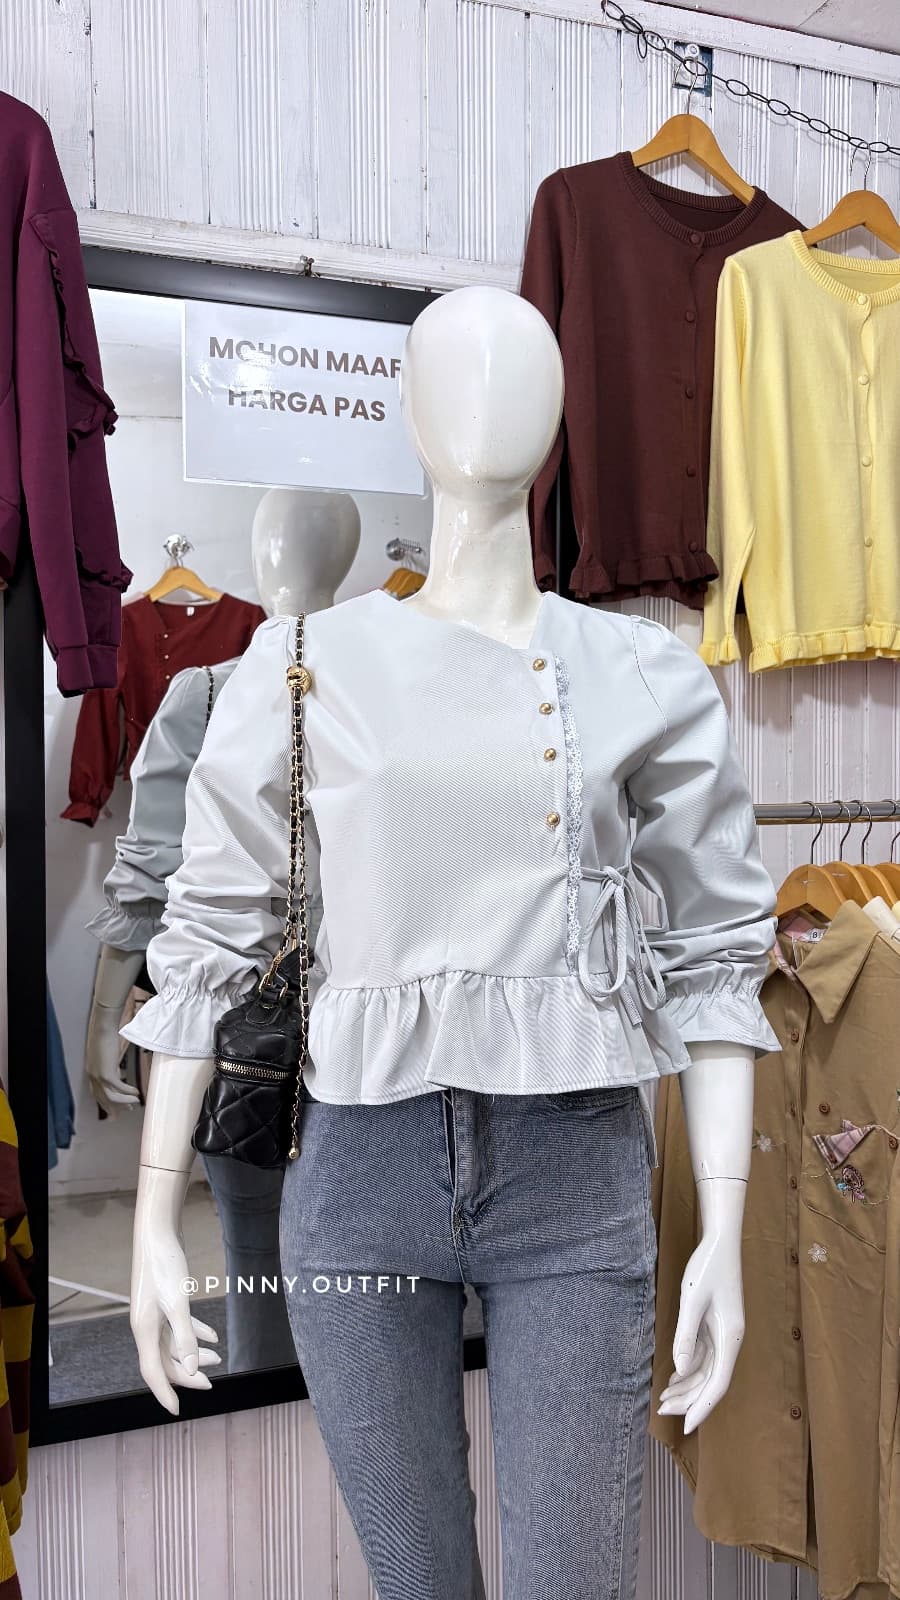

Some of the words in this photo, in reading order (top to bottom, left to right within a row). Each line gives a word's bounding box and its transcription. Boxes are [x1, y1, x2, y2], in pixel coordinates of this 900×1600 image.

[209, 336, 319, 370] MOHON
[228, 388, 328, 416] HARGA
[334, 396, 386, 422] PAS
